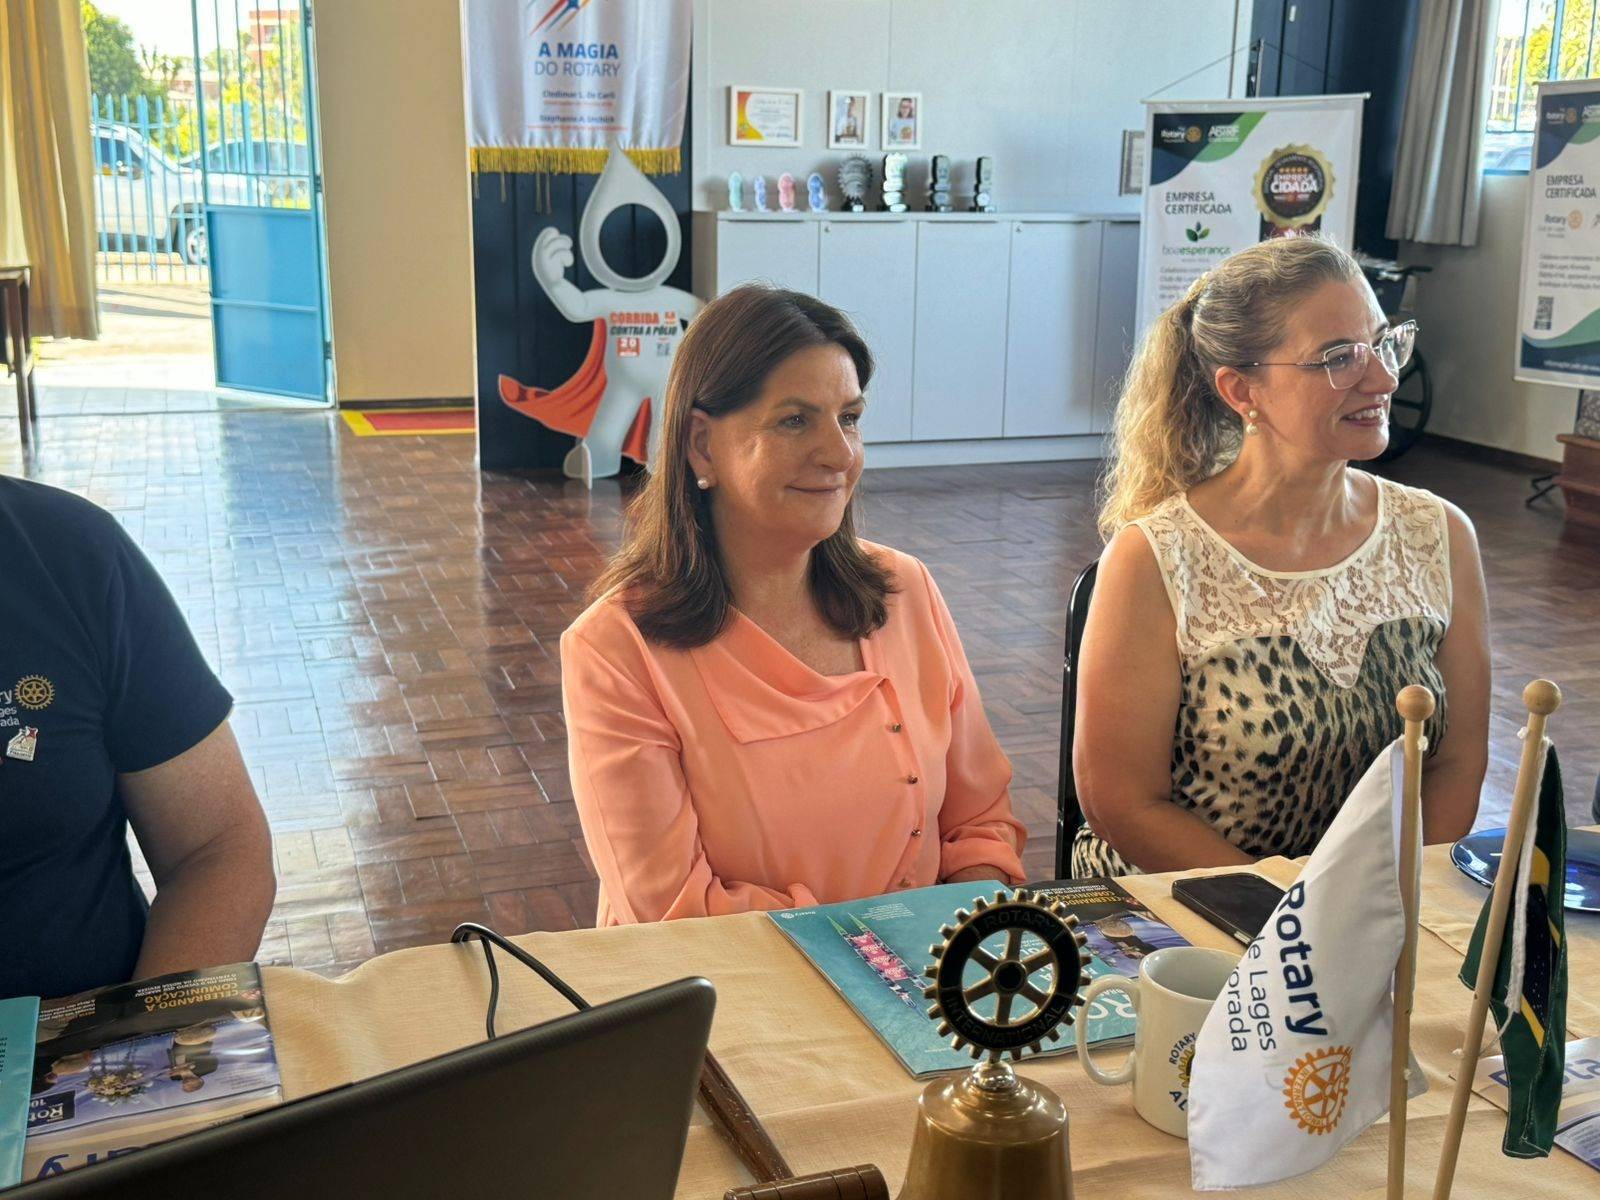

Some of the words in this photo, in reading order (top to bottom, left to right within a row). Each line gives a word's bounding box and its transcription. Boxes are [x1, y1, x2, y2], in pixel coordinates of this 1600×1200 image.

[538, 42, 551, 58] A
[557, 43, 619, 59] MAGIA
[534, 61, 558, 76] DO
[563, 62, 621, 77] ROTARY
[1546, 175, 1584, 186] EMPRESA
[1165, 192, 1215, 202] EMPRESA
[1545, 186, 1597, 198] CERTIFICADA
[1165, 203, 1232, 215] CERTIFICADA
[610, 311, 659, 325] CORRIDA
[610, 326, 643, 336] CONTRA
[645, 326, 651, 336] A
[1276, 880, 1328, 1036] Rotary
[144, 982, 238, 1004] COMUNICAÇÃO
[160, 990, 239, 1010] CELEBRANDO
[145, 1004, 155, 1012] A
[1227, 966, 1252, 1051] orada
[1248, 970, 1276, 1051] Lages
[1168, 1032, 1197, 1065] ROTARY
